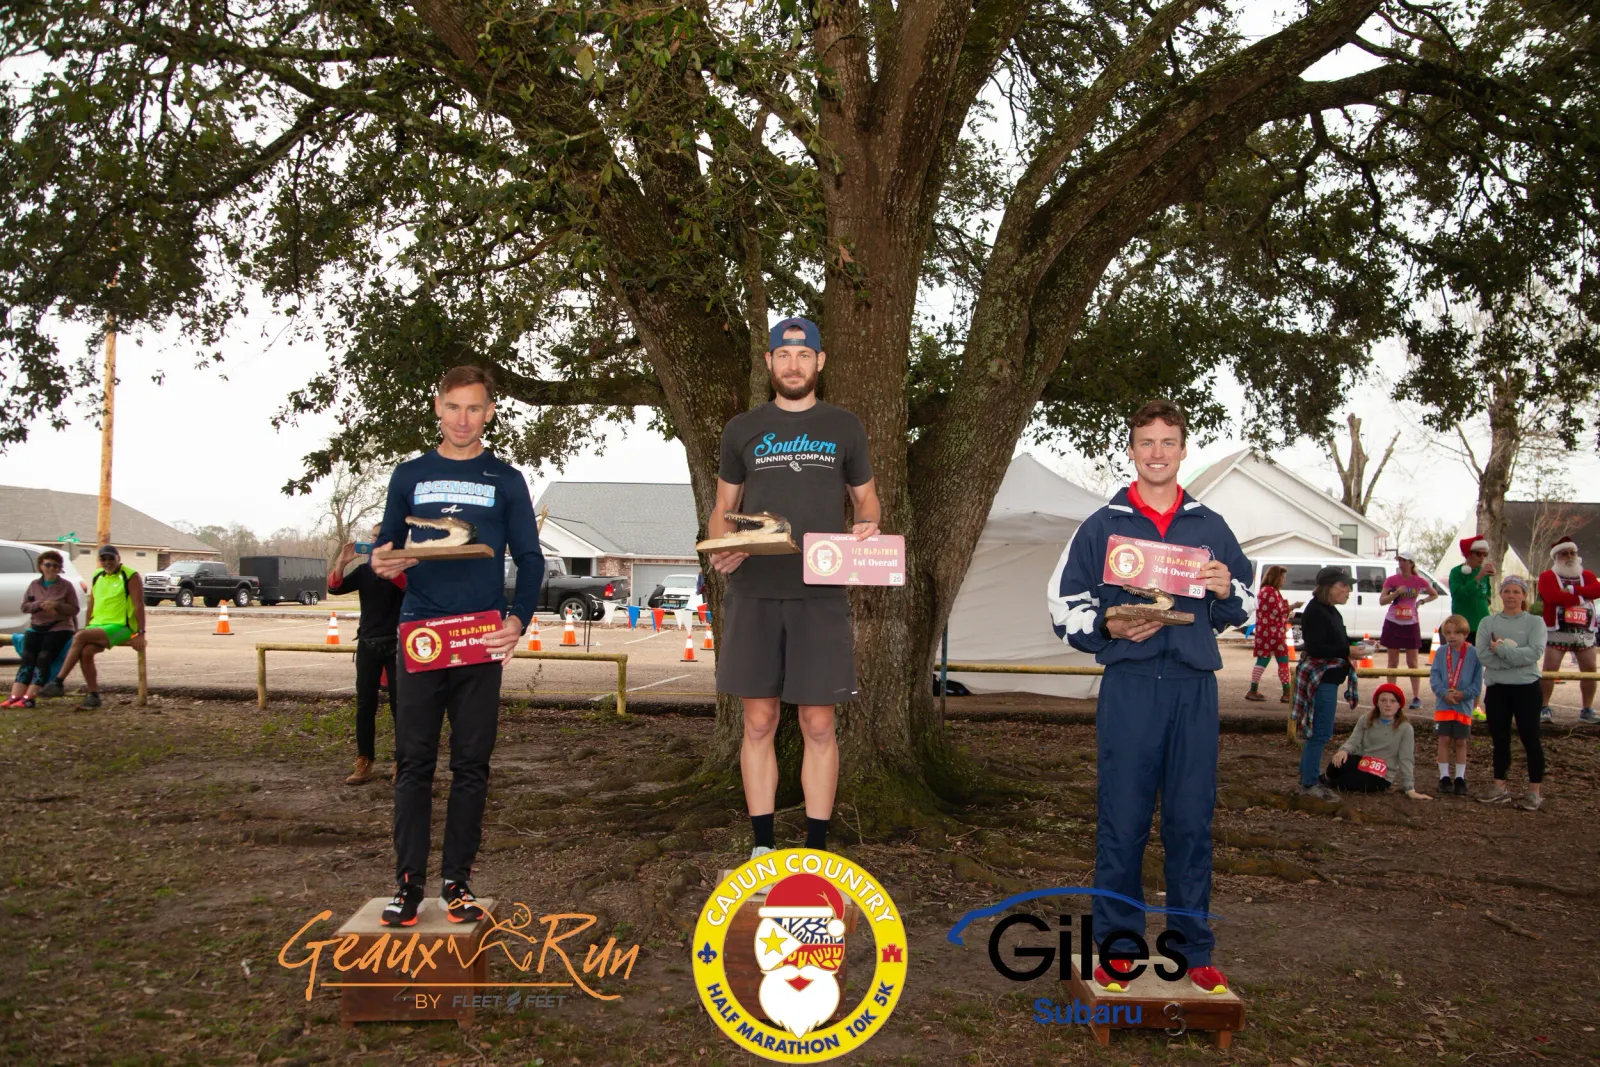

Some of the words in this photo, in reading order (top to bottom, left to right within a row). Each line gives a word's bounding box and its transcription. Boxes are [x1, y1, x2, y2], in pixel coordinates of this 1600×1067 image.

[754, 432, 837, 457] Southern
[755, 453, 794, 465] RUNNING
[795, 453, 836, 464] COMPANY
[414, 480, 496, 498] ASCENSION
[419, 494, 445, 503] CROSS
[447, 494, 488, 505] COUNTRY
[1134, 540, 1183, 552] CajunCountry.Run
[852, 558, 867, 567] 1st
[868, 558, 898, 567] Overall
[1152, 564, 1168, 575] 3rd
[1192, 587, 1201, 595] 20
[425, 615, 475, 627] CajunCountry.Run
[1573, 611, 1587, 621] 370
[448, 629, 460, 637] 1/2
[450, 639, 467, 648] 2nd
[1163, 1002, 1187, 1037] 3
